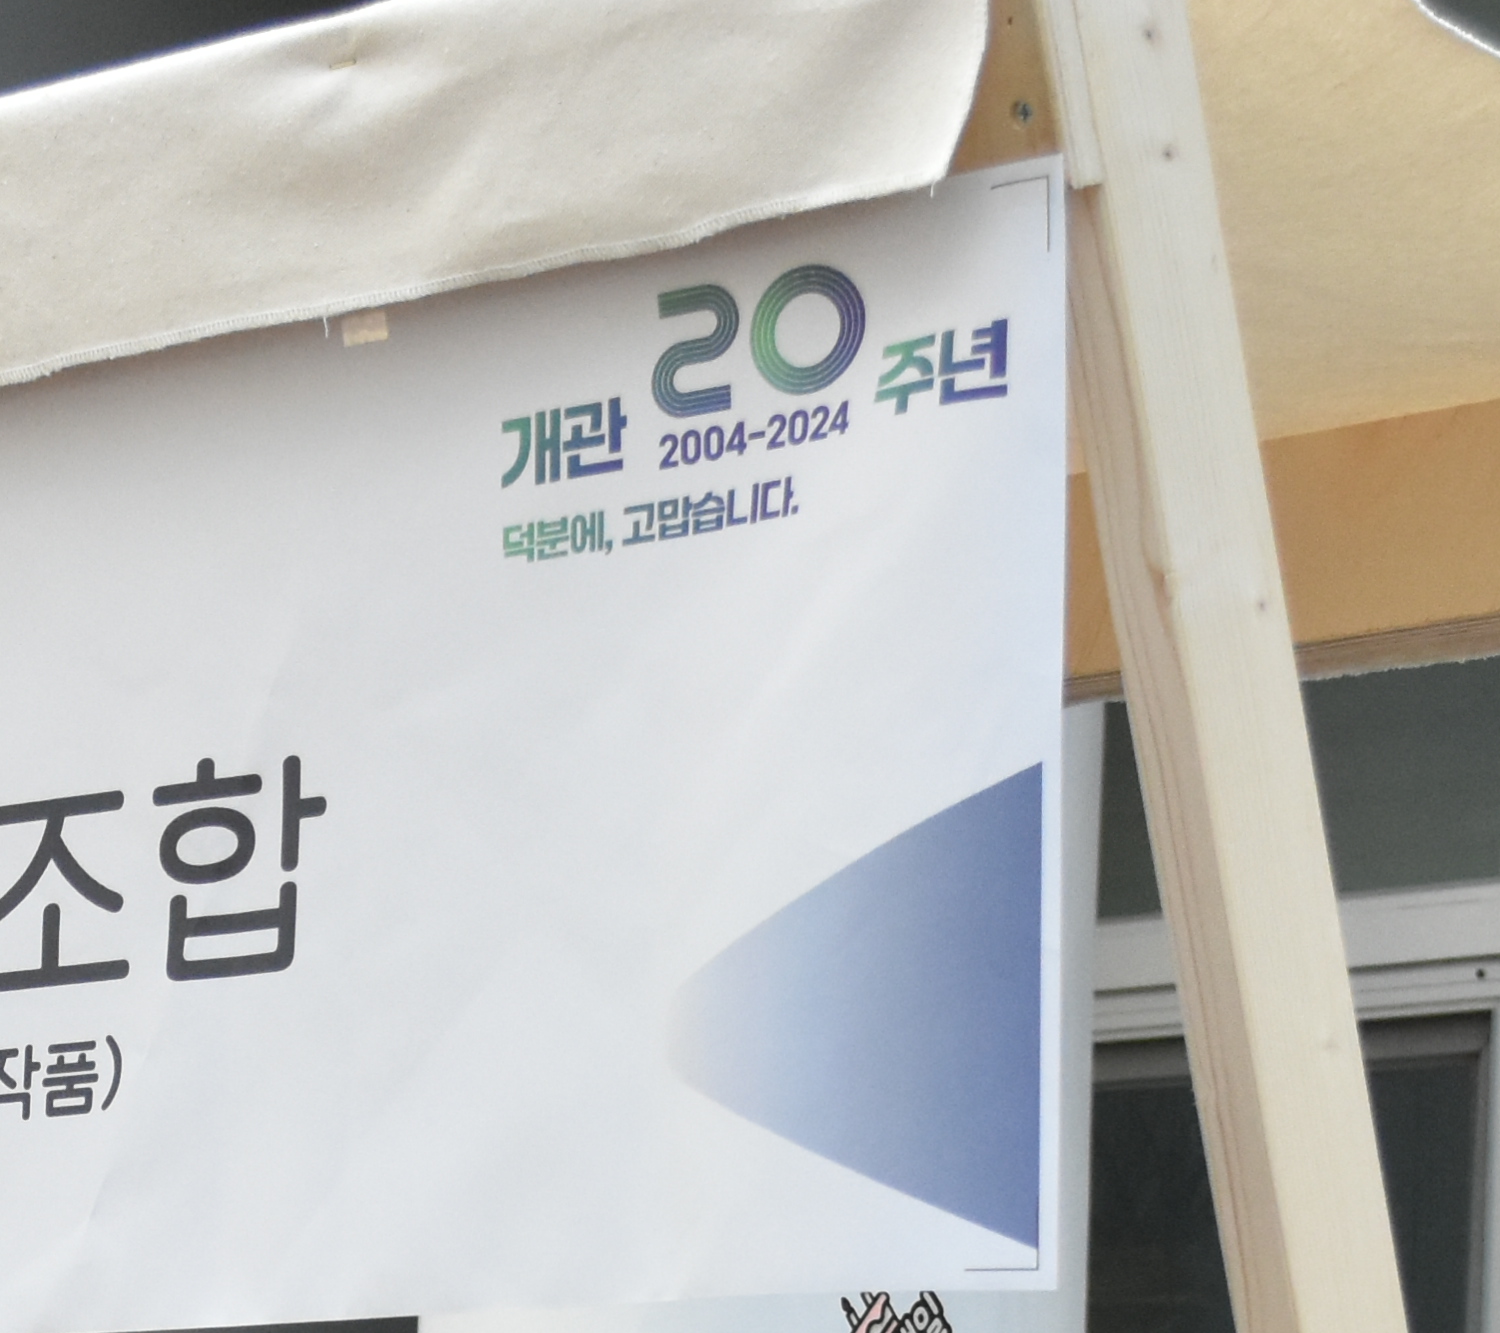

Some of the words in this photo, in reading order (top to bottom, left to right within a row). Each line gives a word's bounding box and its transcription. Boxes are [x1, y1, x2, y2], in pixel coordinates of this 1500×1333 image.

[499, 396, 628, 489] 개관
[650, 262, 868, 419] 20
[872, 316, 1010, 416] 주년
[657, 399, 851, 471] 2004-2024
[500, 509, 615, 564] 덕분에,
[621, 475, 800, 548] 고맙습니다.
